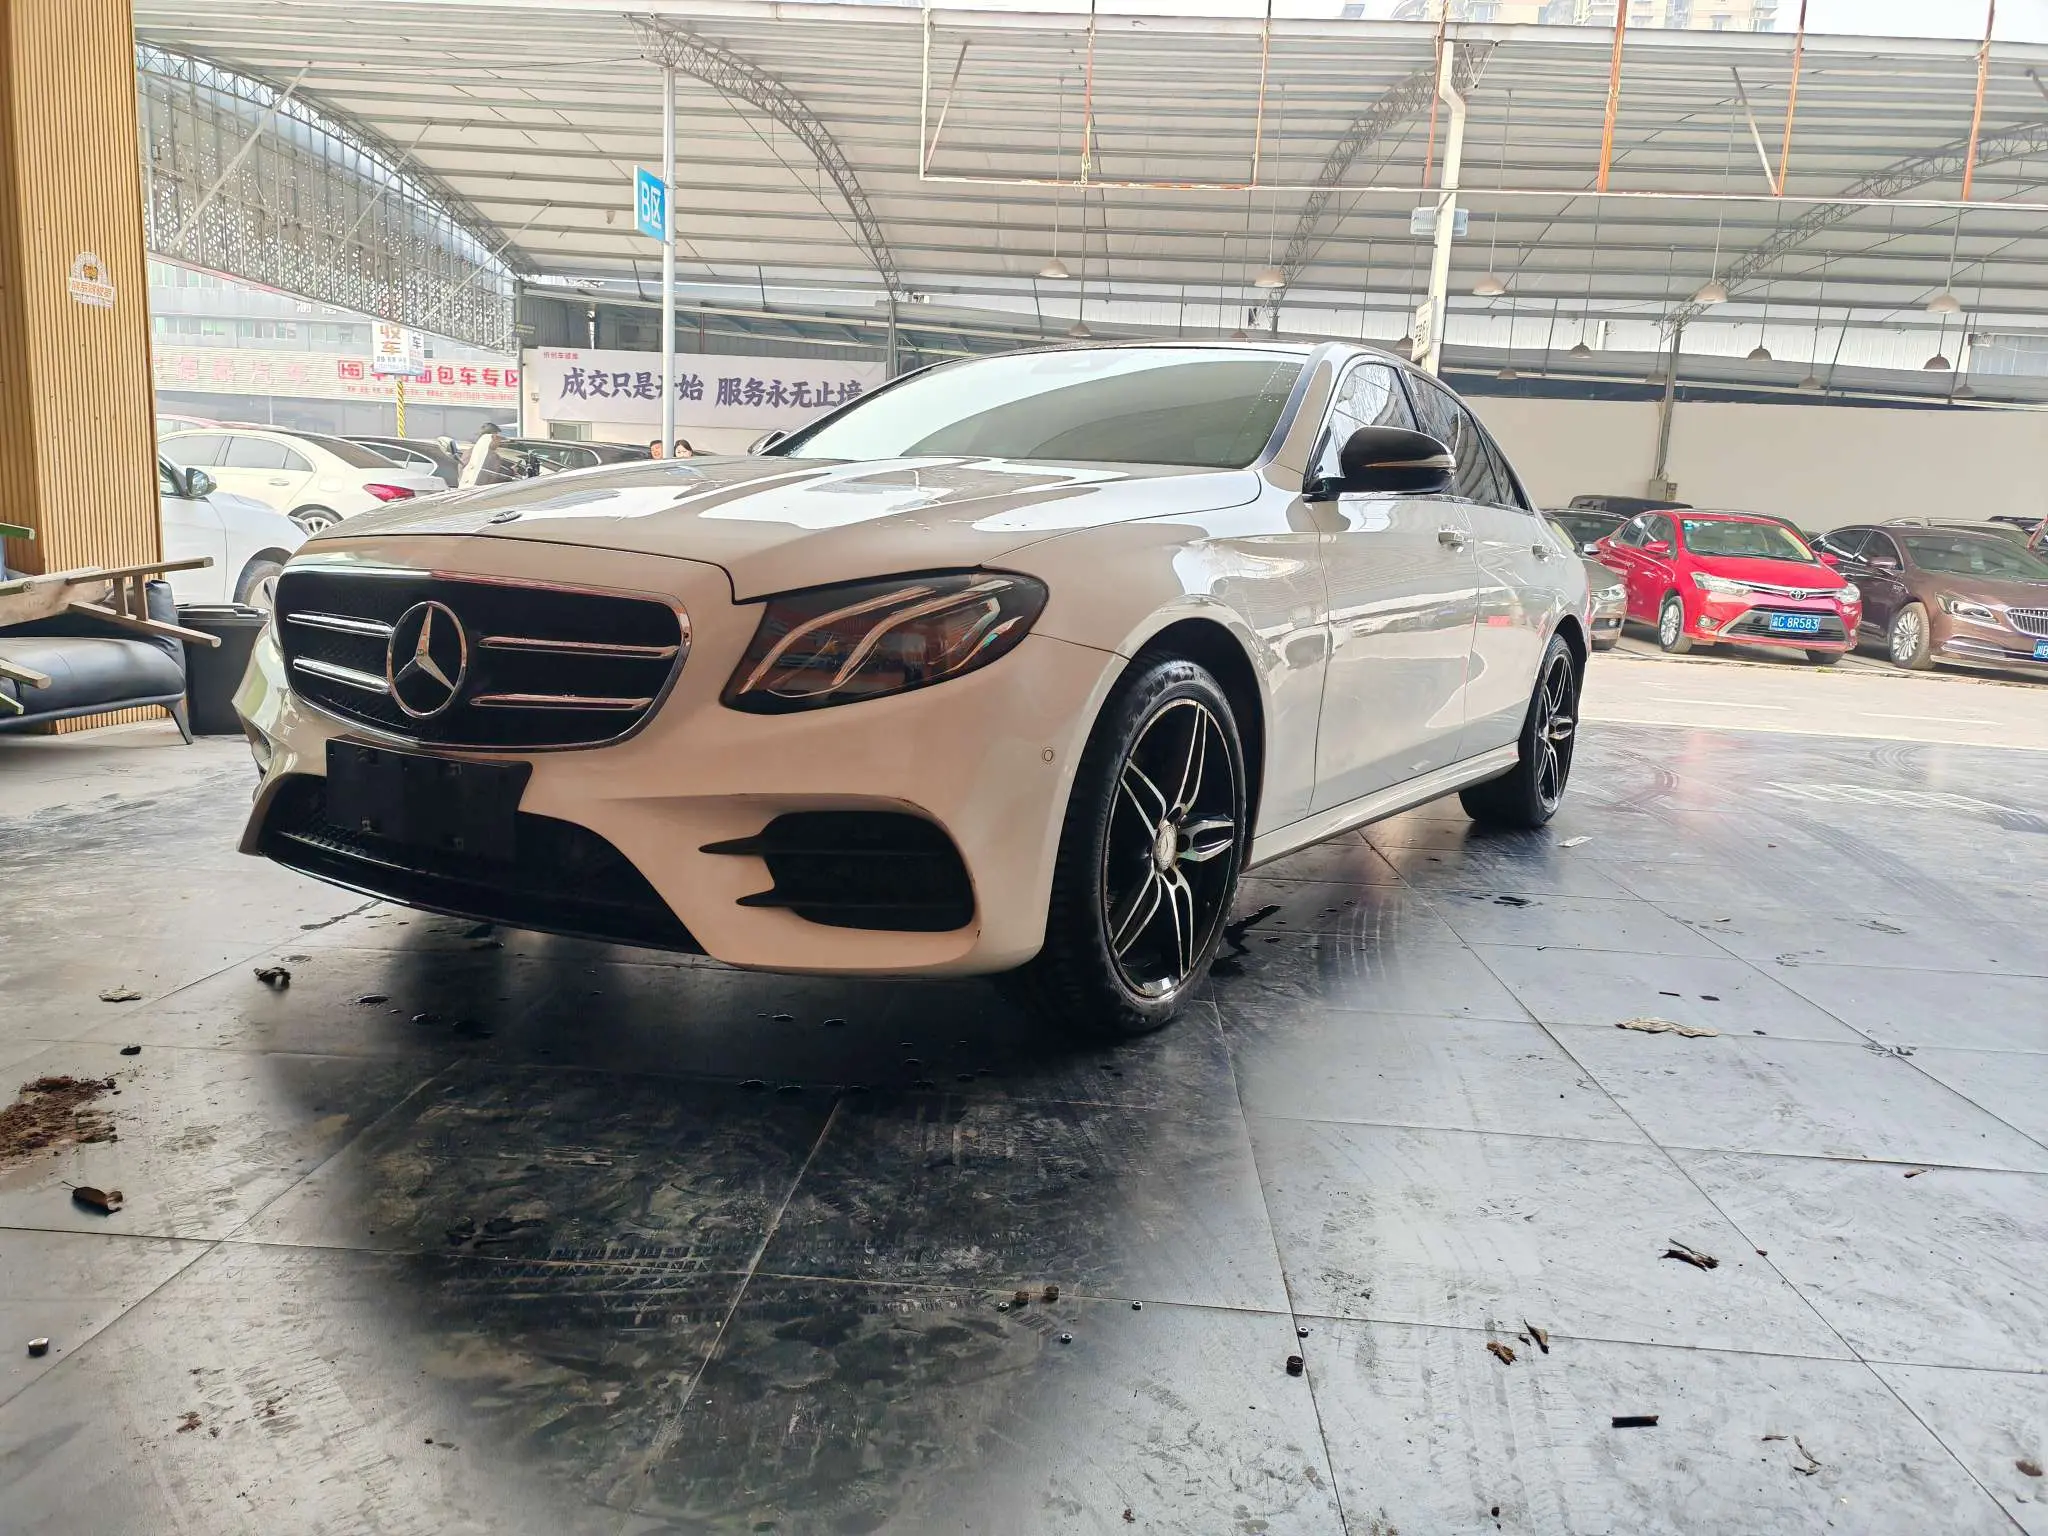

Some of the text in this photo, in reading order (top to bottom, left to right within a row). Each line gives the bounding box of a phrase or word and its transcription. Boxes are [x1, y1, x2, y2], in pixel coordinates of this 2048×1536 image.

[641, 181, 662, 229] B区
[715, 377, 864, 409] 服务永无止境
